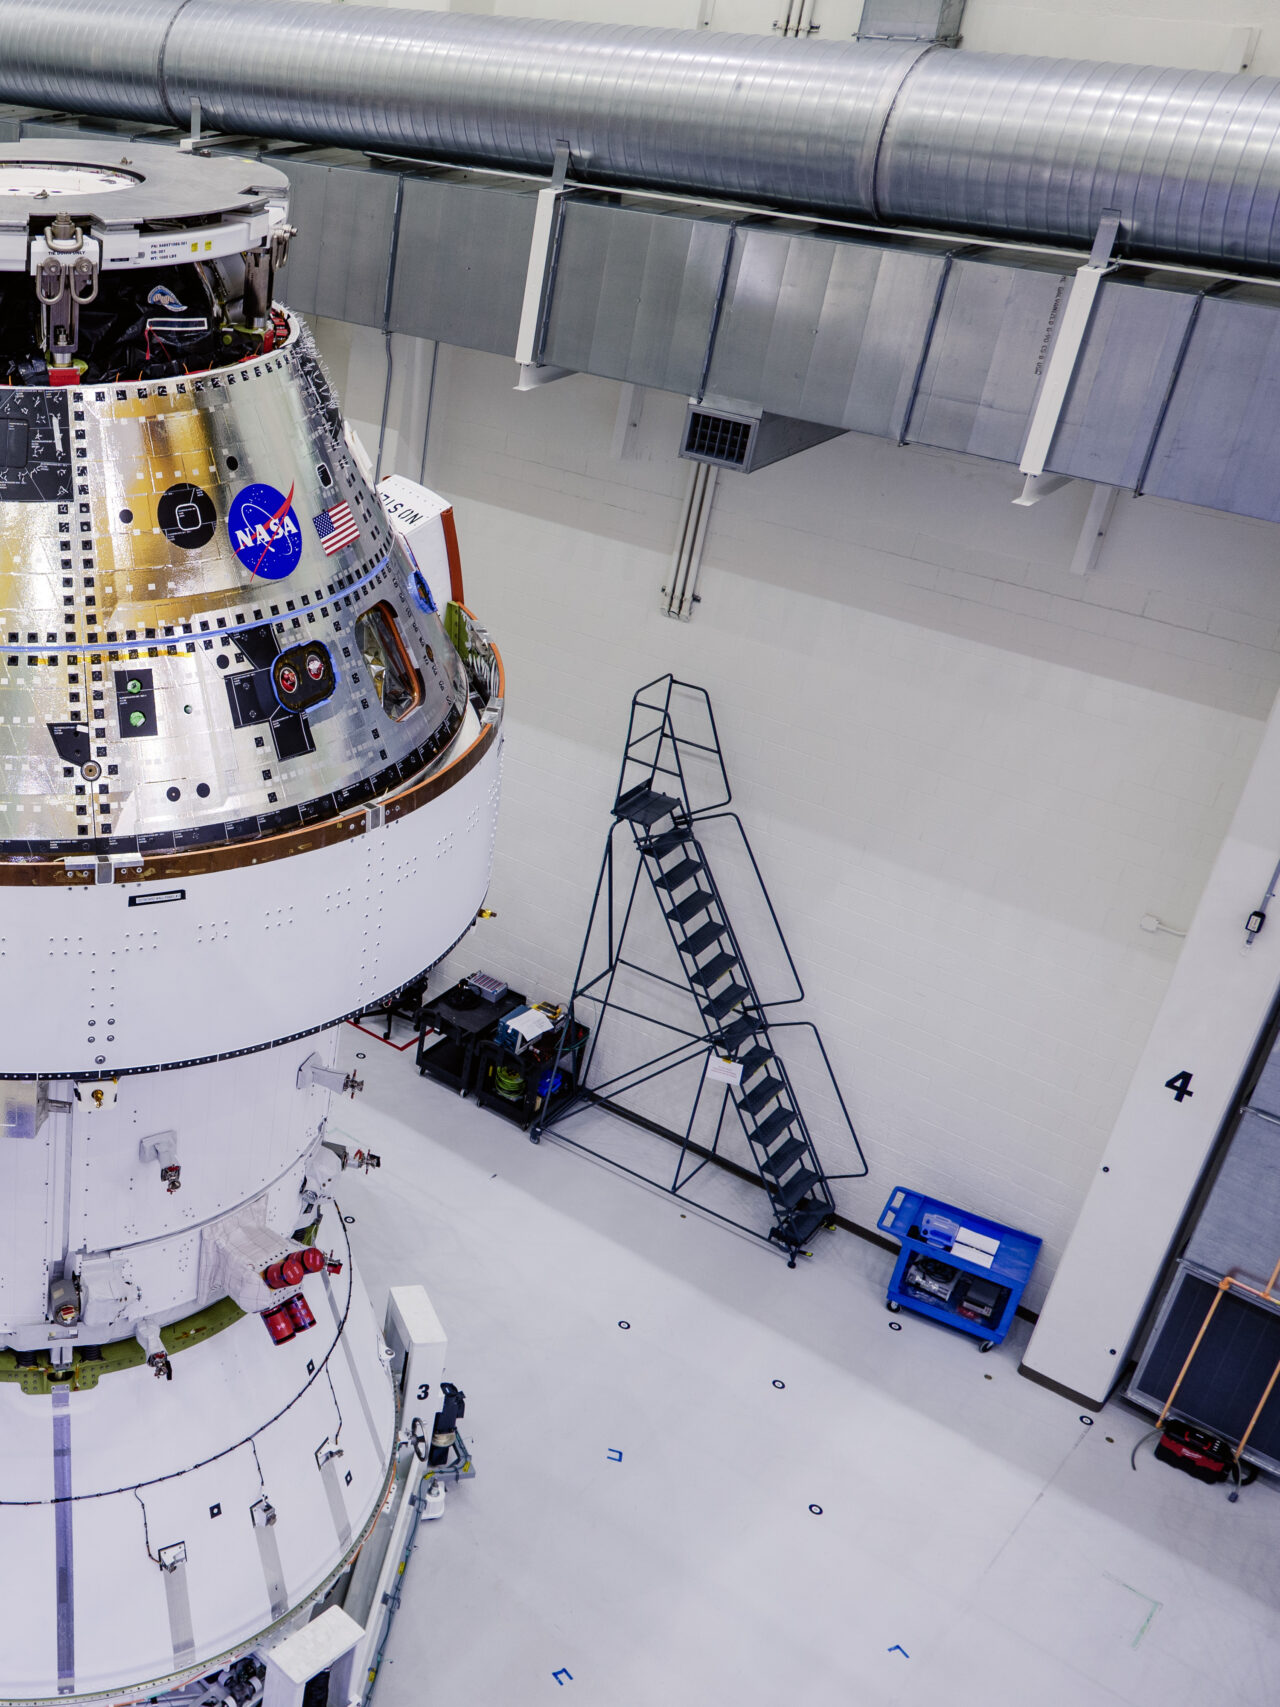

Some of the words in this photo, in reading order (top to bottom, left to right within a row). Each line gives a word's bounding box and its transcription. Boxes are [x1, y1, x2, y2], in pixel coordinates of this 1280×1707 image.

[235, 514, 299, 552] NASA
[1165, 1071, 1193, 1102] 4
[417, 1384, 429, 1400] 3
